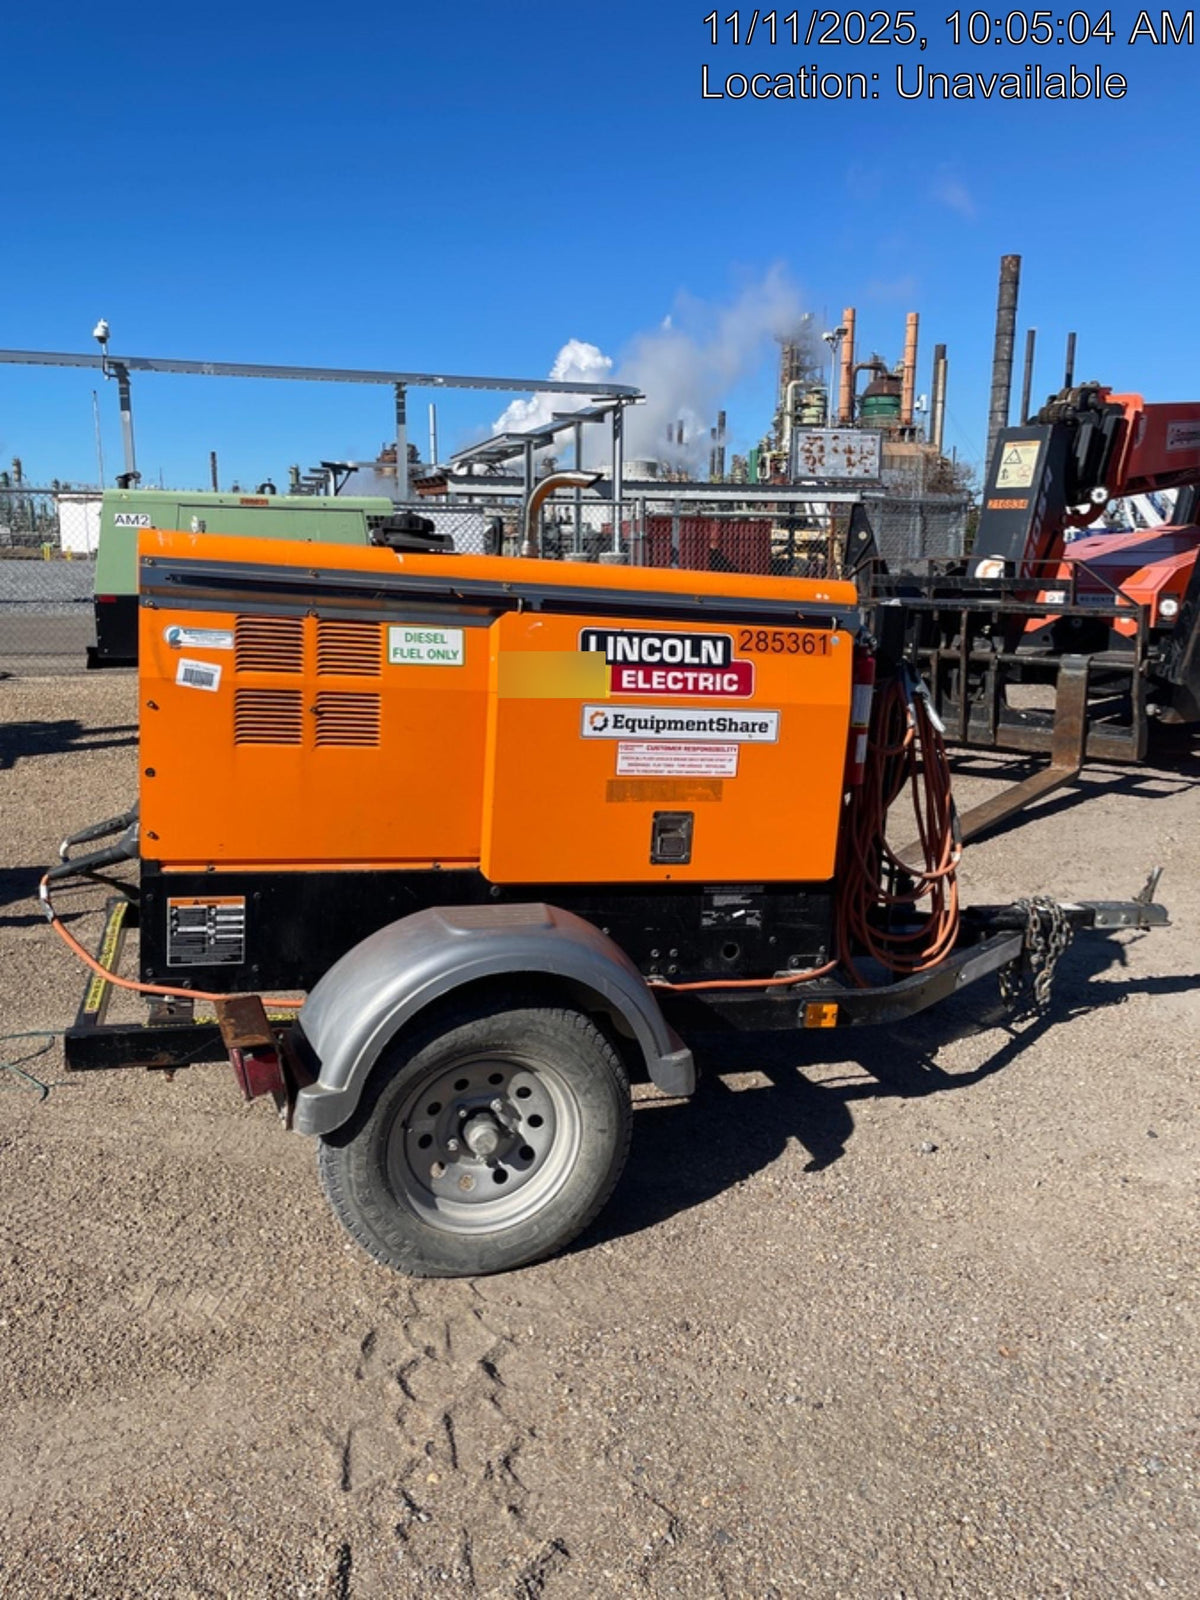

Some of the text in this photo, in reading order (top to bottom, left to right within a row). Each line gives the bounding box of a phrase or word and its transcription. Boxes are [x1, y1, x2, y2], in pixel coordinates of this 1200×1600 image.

[115, 515, 149, 525] AM2
[404, 632, 448, 644] DIESEL
[740, 630, 827, 655] 285361
[392, 647, 459, 660] FUEL ONLY
[621, 670, 739, 691] ELECTRIC
[612, 714, 769, 735] EquipmentShare
